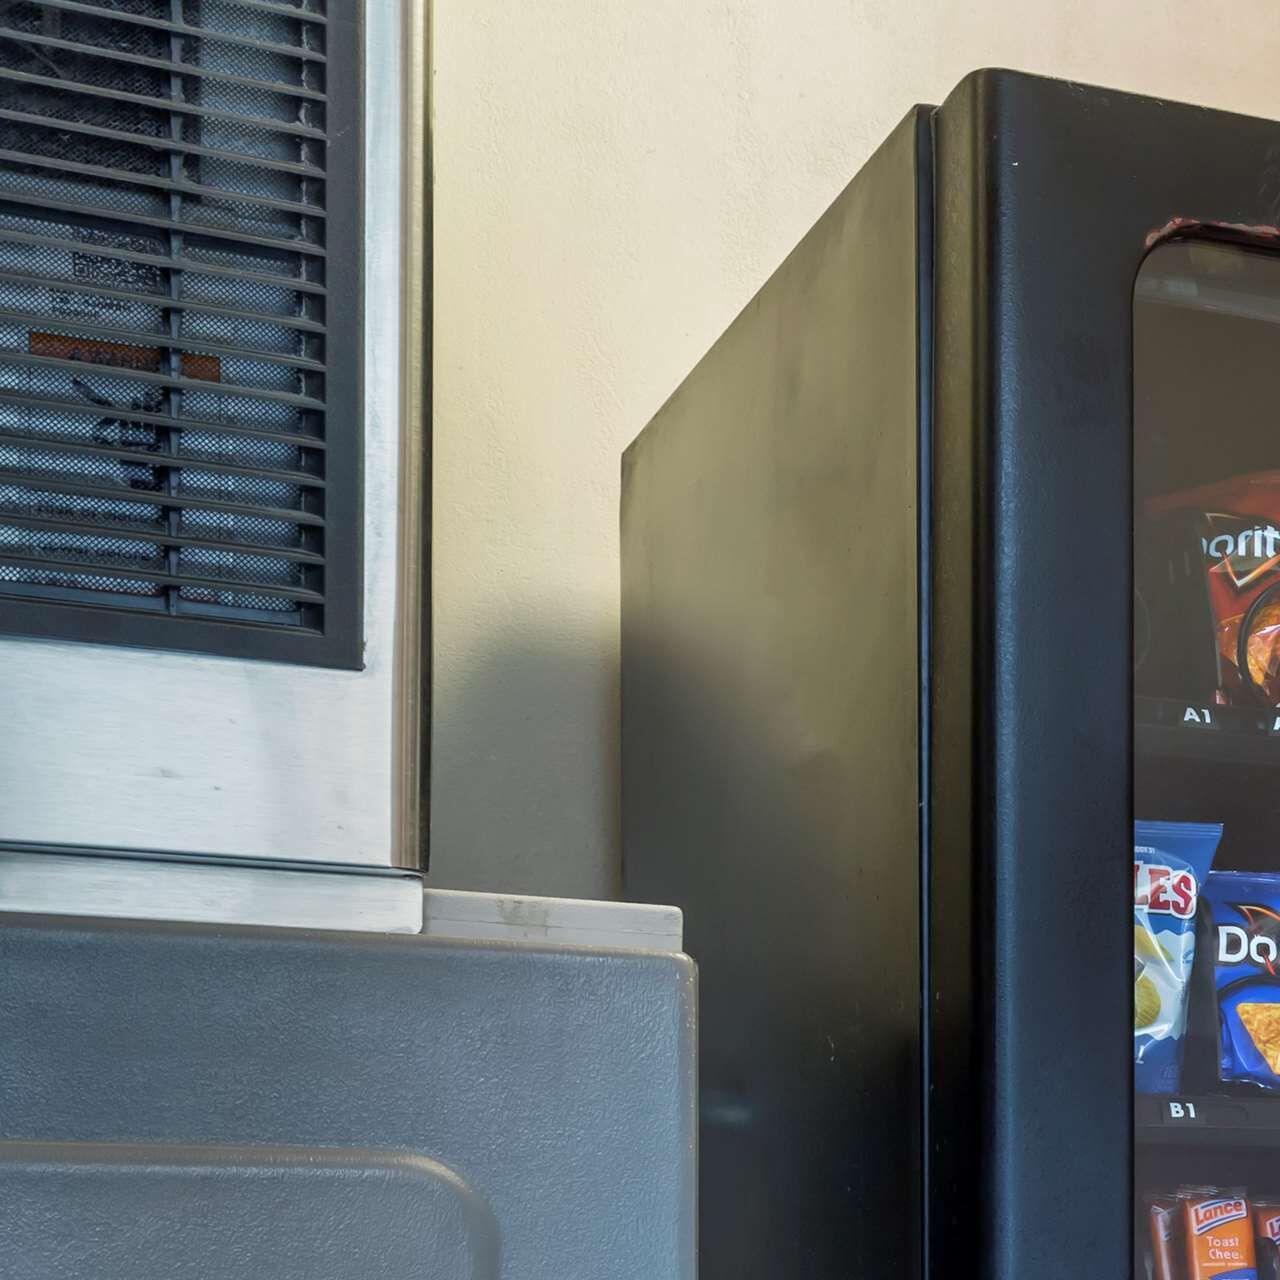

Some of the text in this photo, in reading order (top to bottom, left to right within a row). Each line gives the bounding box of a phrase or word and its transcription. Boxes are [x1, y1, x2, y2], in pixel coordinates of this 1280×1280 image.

[1183, 707, 1211, 723] A1
[1170, 1103, 1195, 1118] B1
[1194, 1200, 1243, 1226] Lance
[1206, 1236, 1239, 1247] Toast
